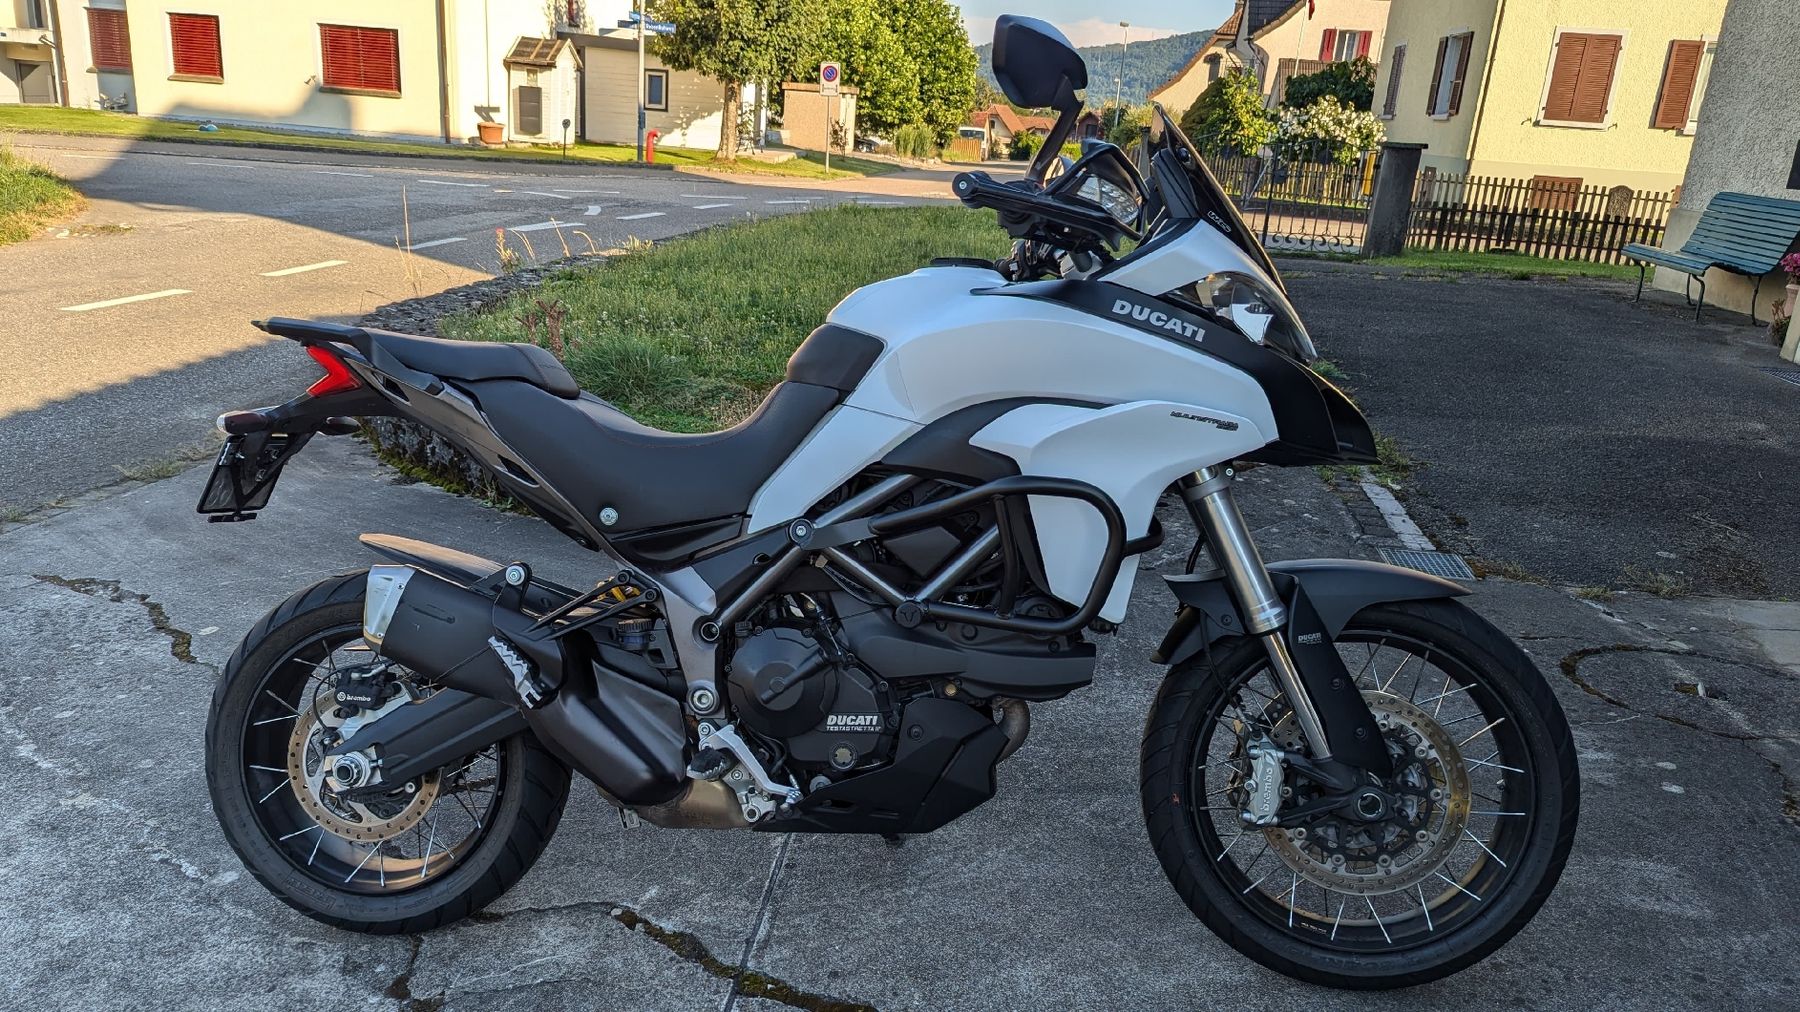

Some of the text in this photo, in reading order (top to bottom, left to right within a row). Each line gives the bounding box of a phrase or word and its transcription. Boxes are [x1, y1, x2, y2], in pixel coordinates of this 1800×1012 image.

[1111, 299, 1206, 342] DUCATI
[1298, 632, 1321, 640] DUCATI
[346, 694, 371, 702] brembo
[826, 715, 878, 725] DUCATI
[1260, 767, 1273, 812] brembo
